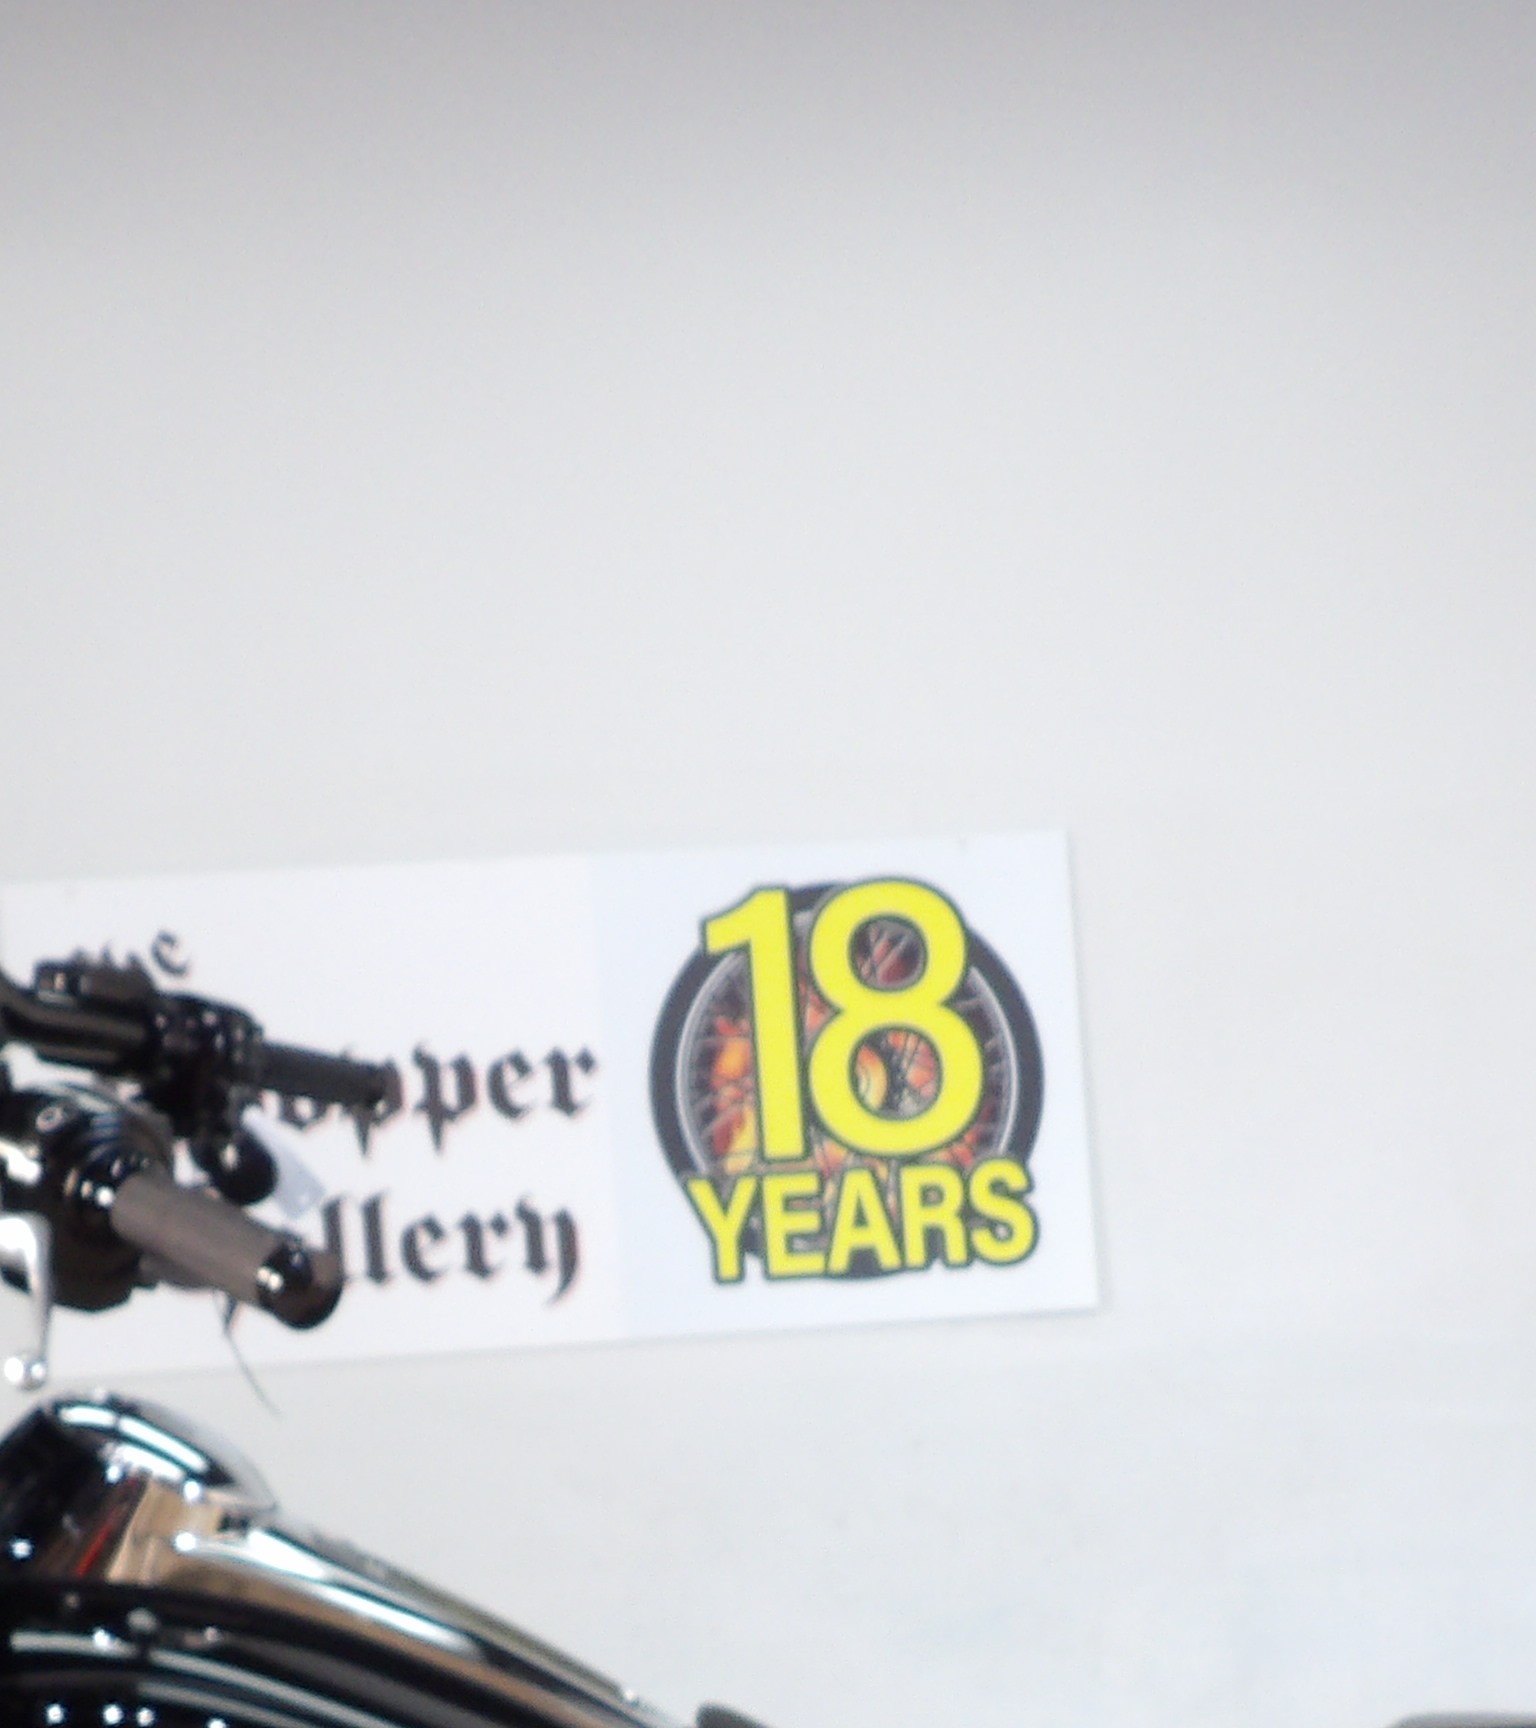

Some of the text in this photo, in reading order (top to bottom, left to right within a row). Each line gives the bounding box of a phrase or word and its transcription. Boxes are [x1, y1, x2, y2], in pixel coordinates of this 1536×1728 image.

[701, 878, 984, 1160] 18
[321, 1191, 579, 1304] llery
[686, 1157, 1040, 1285] YEARS
